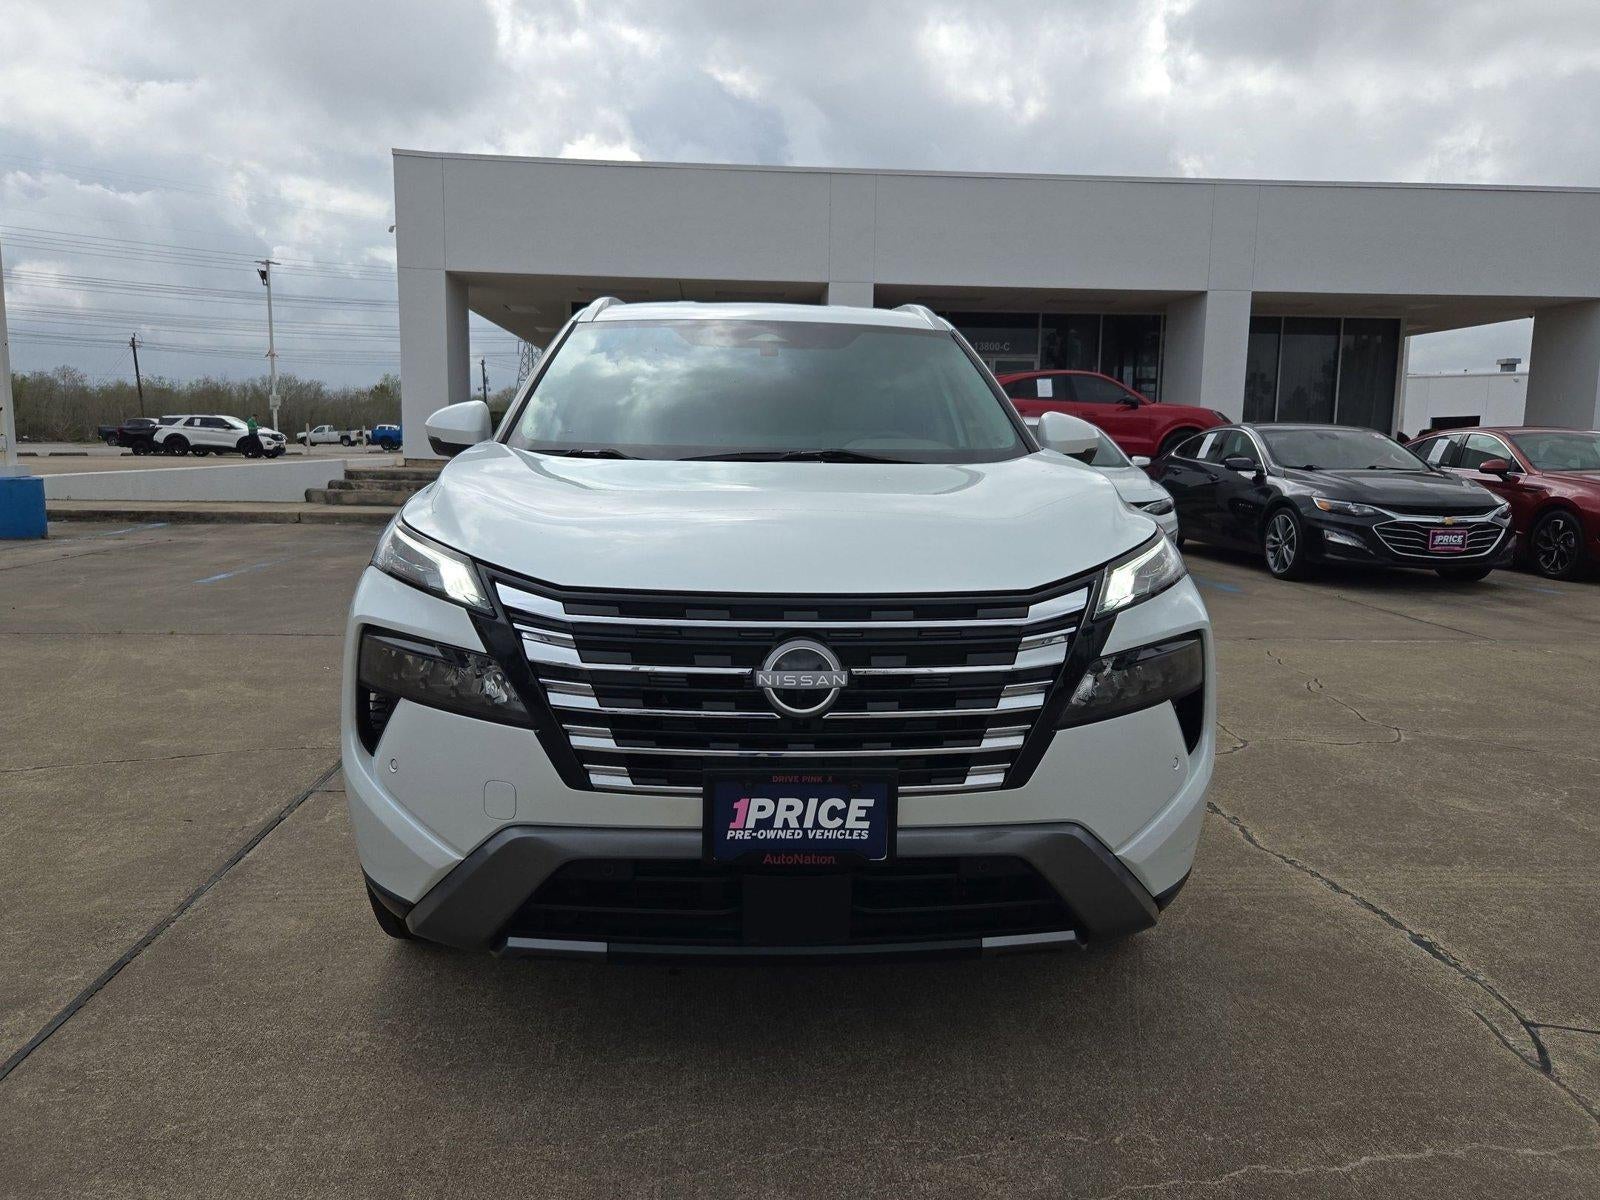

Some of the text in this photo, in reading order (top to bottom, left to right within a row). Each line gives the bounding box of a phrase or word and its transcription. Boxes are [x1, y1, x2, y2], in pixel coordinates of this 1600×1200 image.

[974, 342, 1010, 351] 13800-C
[758, 674, 846, 686] NISSAN
[772, 775, 800, 783] DRIVE
[802, 775, 823, 783] PINK
[728, 797, 875, 829] 1PRICE
[726, 829, 869, 840] PRE-OWNED VEHICLES
[762, 853, 836, 865] AutoNation
